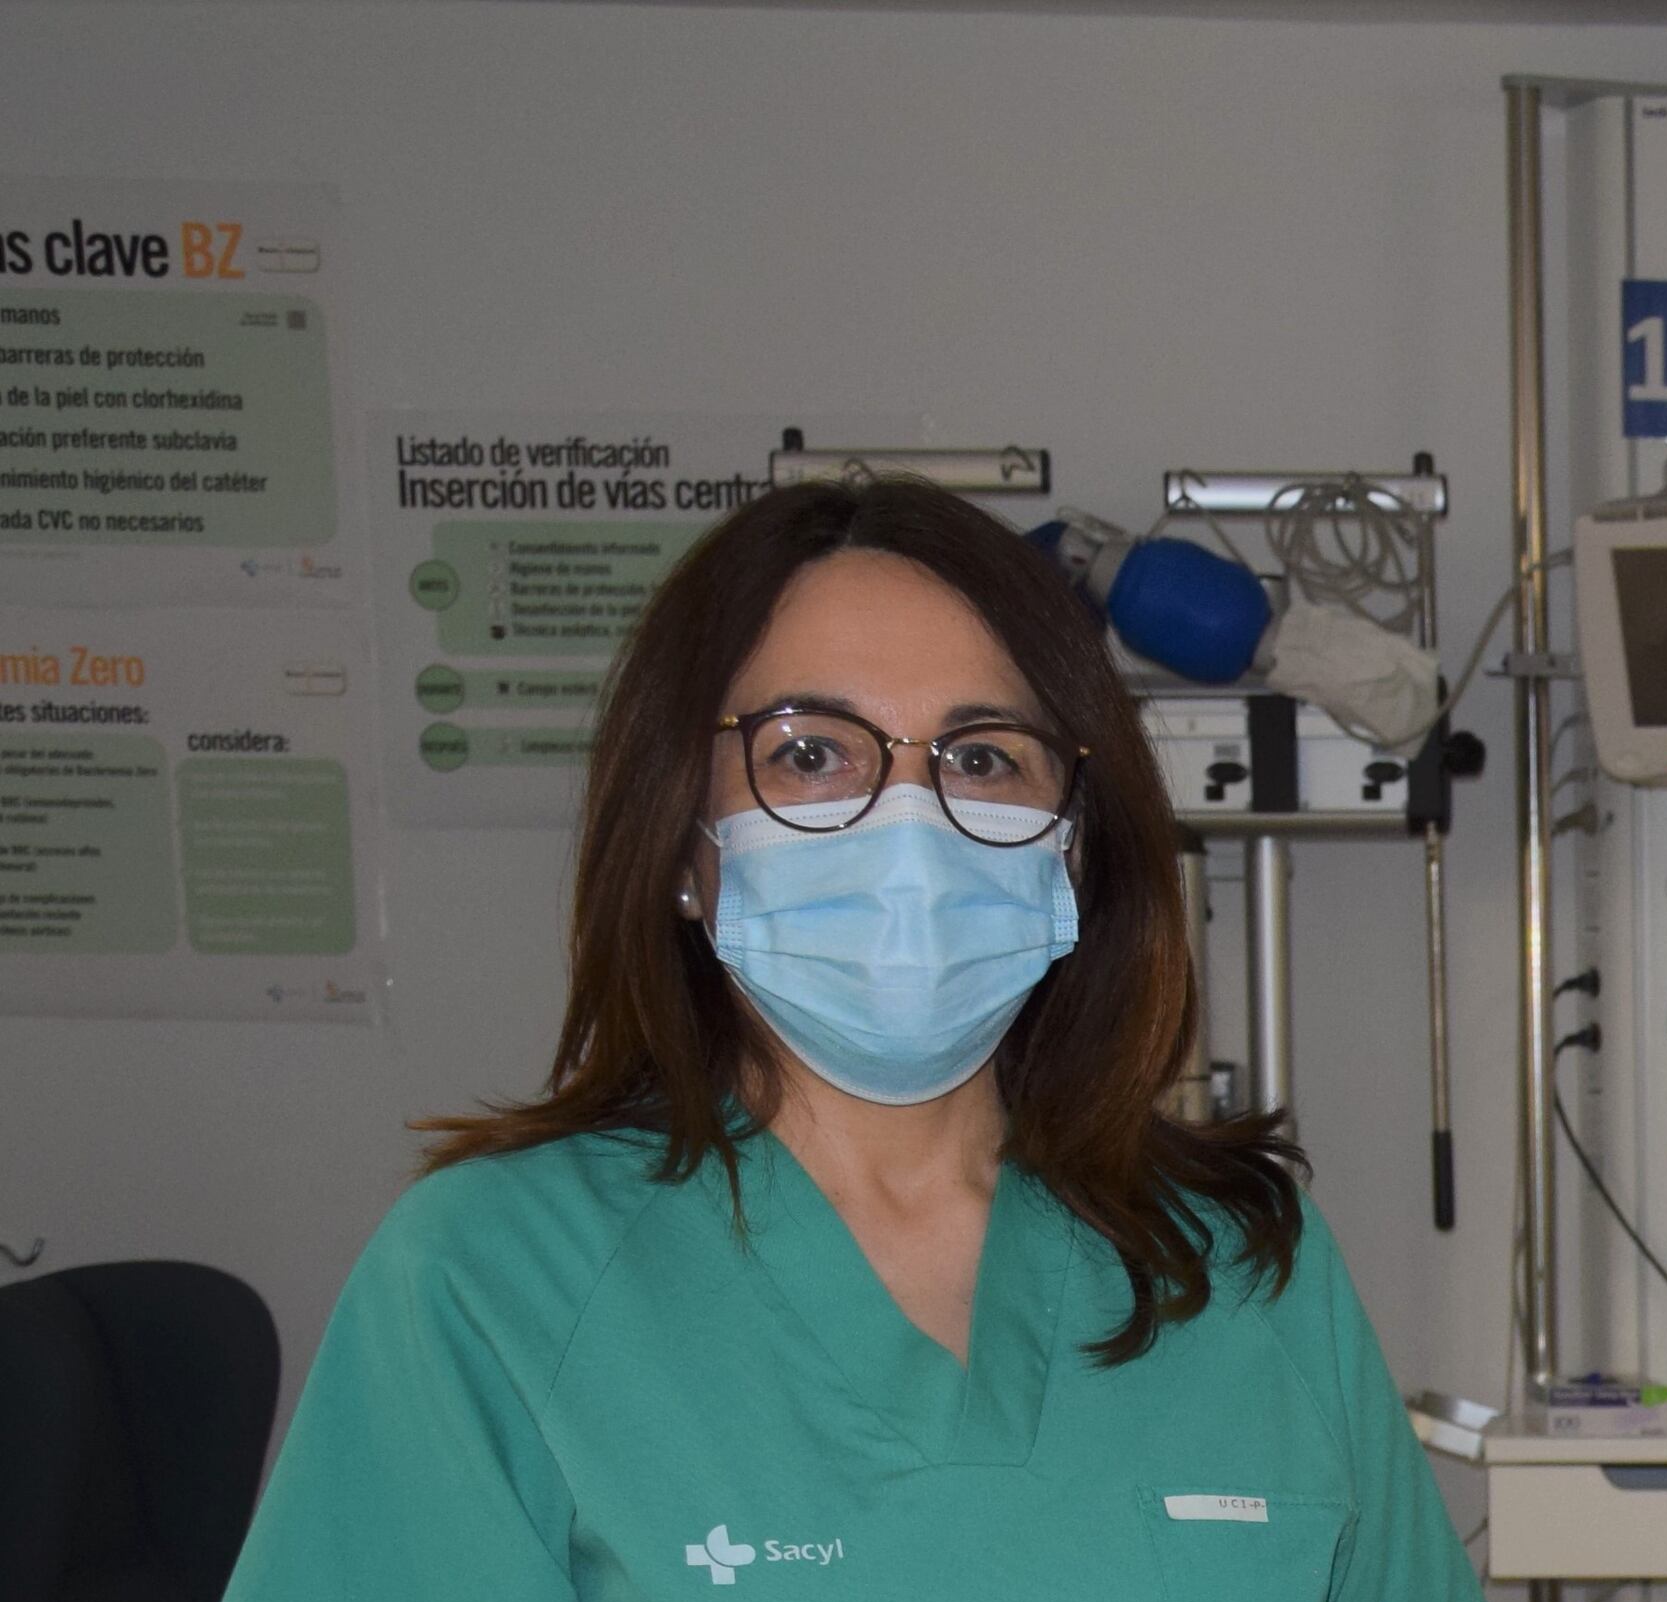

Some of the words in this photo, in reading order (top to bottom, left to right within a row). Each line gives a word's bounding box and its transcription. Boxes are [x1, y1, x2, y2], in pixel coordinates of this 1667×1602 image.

[0, 230, 33, 275] s
[44, 218, 170, 278] clave
[181, 221, 246, 280] BZ
[1, 307, 61, 325] manos
[79, 345, 101, 366] de
[107, 346, 205, 369] protección
[8, 387, 30, 407] de
[34, 387, 51, 407] la
[56, 388, 90, 412] piel
[94, 392, 129, 408] con
[132, 389, 243, 411] clorhexidina
[53, 428, 148, 453] preferente
[152, 430, 239, 451] subclavia
[397, 435, 484, 468] Listado
[490, 436, 520, 468] de
[526, 437, 670, 469] verificación
[83, 468, 165, 494] higiénico
[170, 471, 198, 491] del
[203, 472, 268, 493] catéter
[397, 469, 549, 510] Inserción
[557, 471, 596, 509] de
[604, 468, 667, 510] vías
[38, 510, 74, 530] CVC
[79, 514, 101, 531] no
[106, 512, 205, 533] necesarios
[69, 644, 146, 688] Zero
[31, 699, 150, 724] situaciones:
[187, 728, 290, 752] considera:
[764, 1538, 844, 1566] Sacyl
